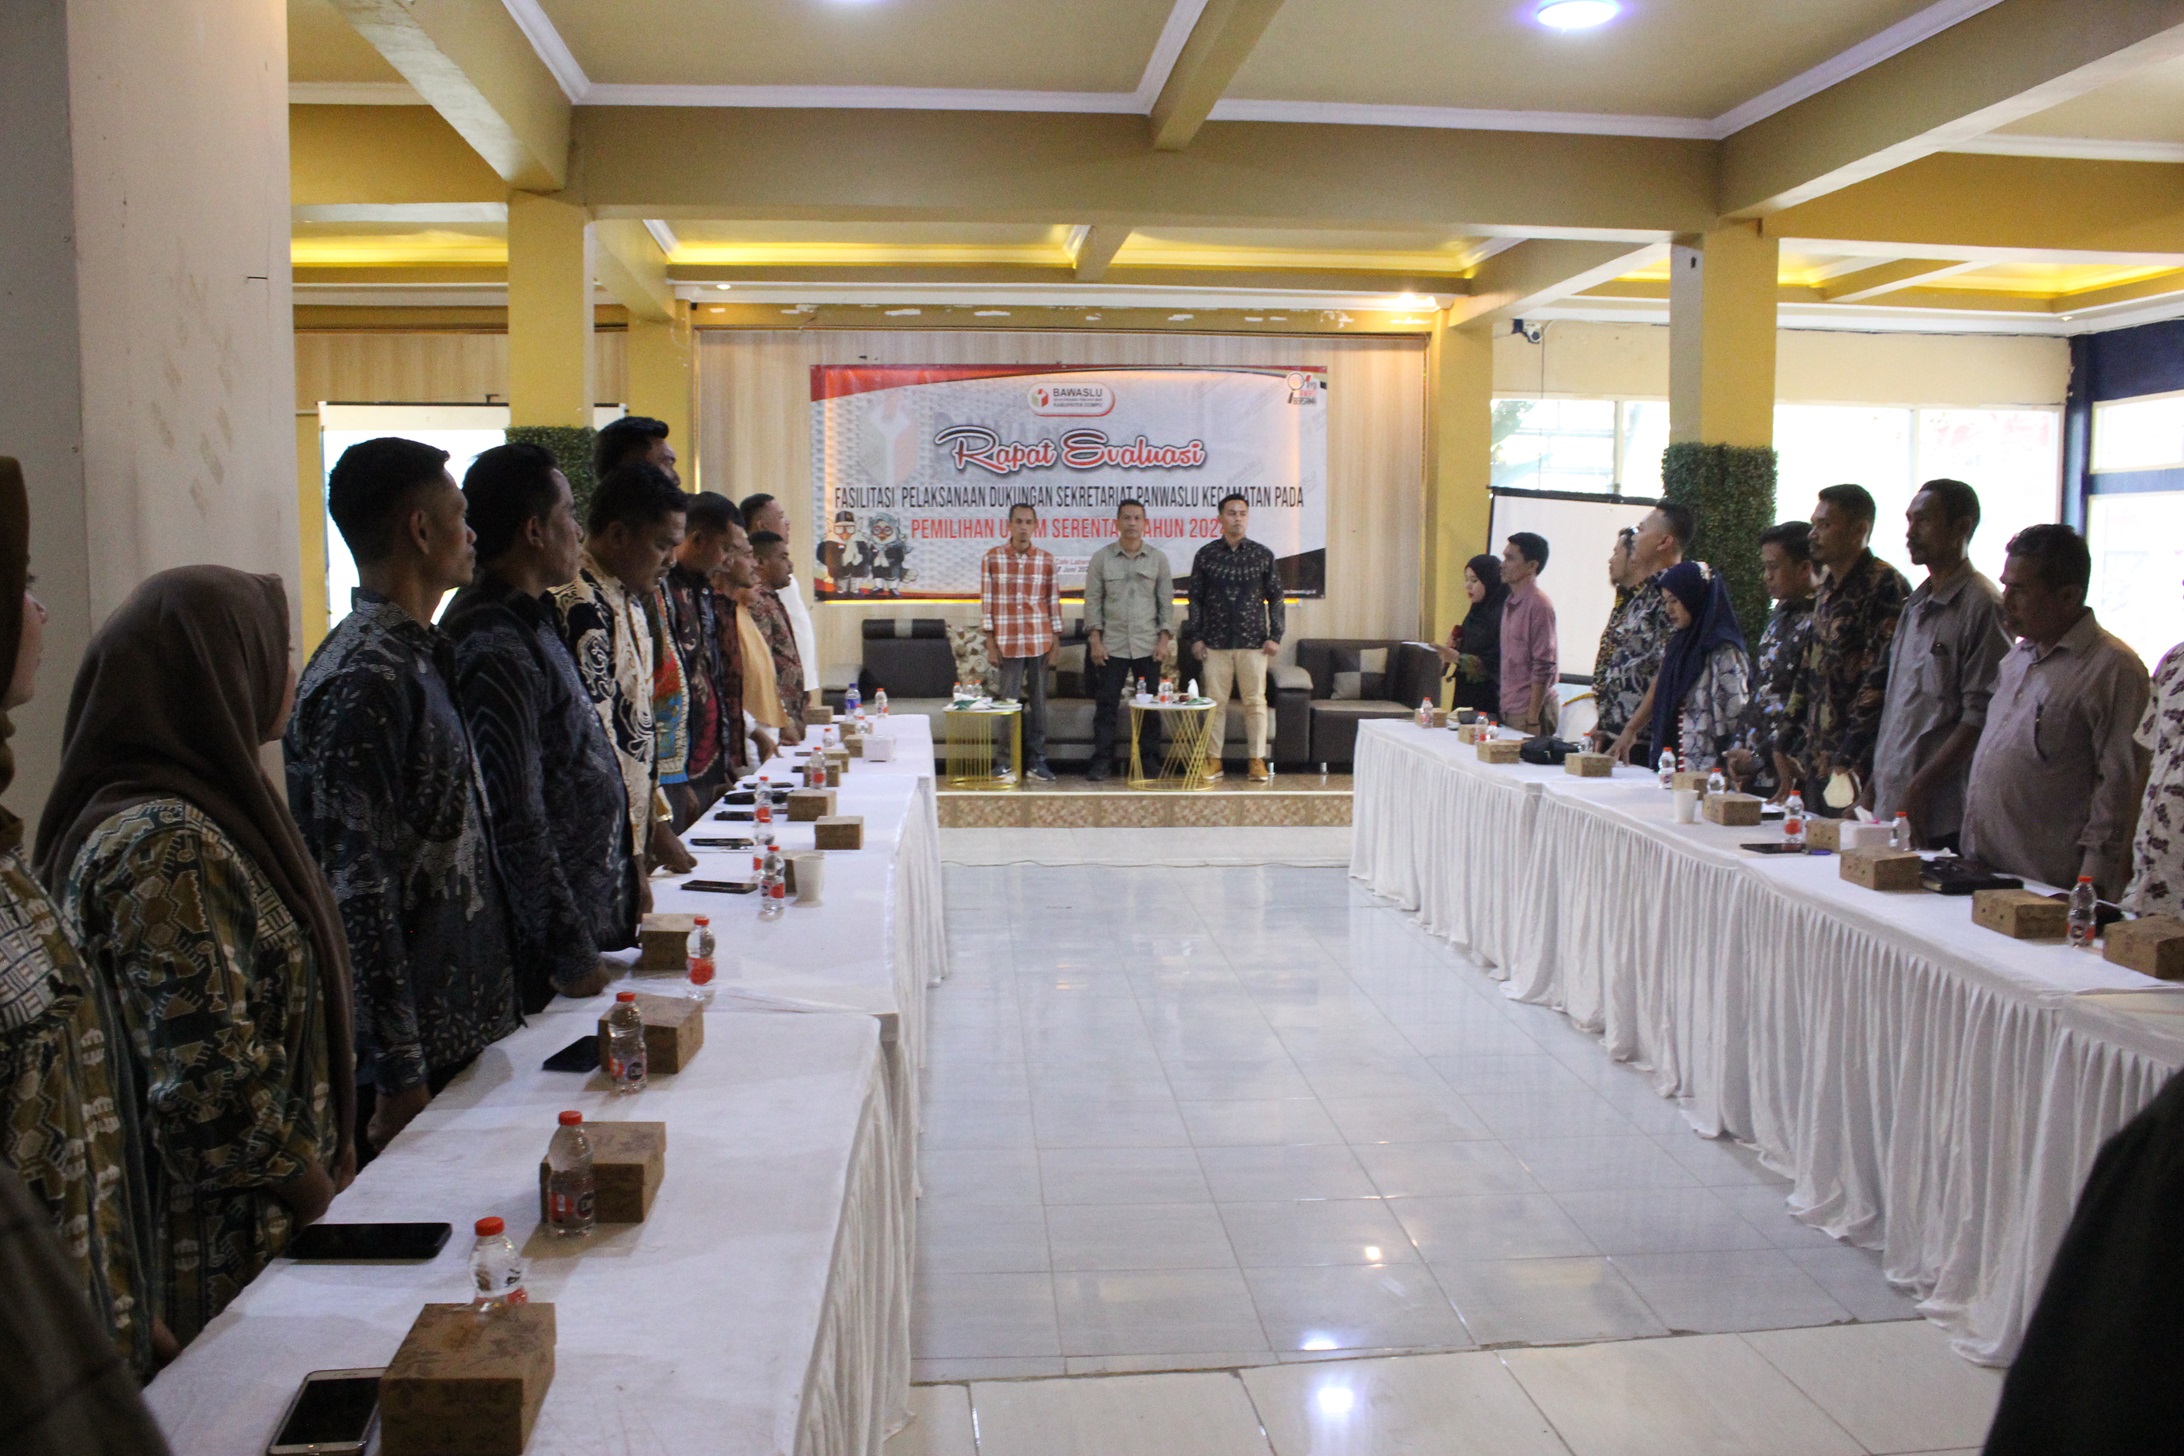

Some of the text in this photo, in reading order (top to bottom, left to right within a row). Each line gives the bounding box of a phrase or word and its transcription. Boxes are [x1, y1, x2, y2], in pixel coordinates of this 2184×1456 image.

[1053, 388, 1103, 397] BAWASLU
[935, 426, 1057, 475] Rapat
[1060, 427, 1207, 471] Evaluasi
[834, 486, 895, 508] FASILITASI
[901, 486, 986, 508] PELAKSANAAN
[989, 486, 1053, 507] DUKUNGAN
[1137, 486, 1199, 507] PANWASLU
[1275, 486, 1304, 507] PADA
[911, 518, 994, 538] PEMILIHAN
[999, 518, 1047, 538] UM
[1052, 518, 1119, 538] SERENTA
[1143, 518, 1184, 538] AHUN
